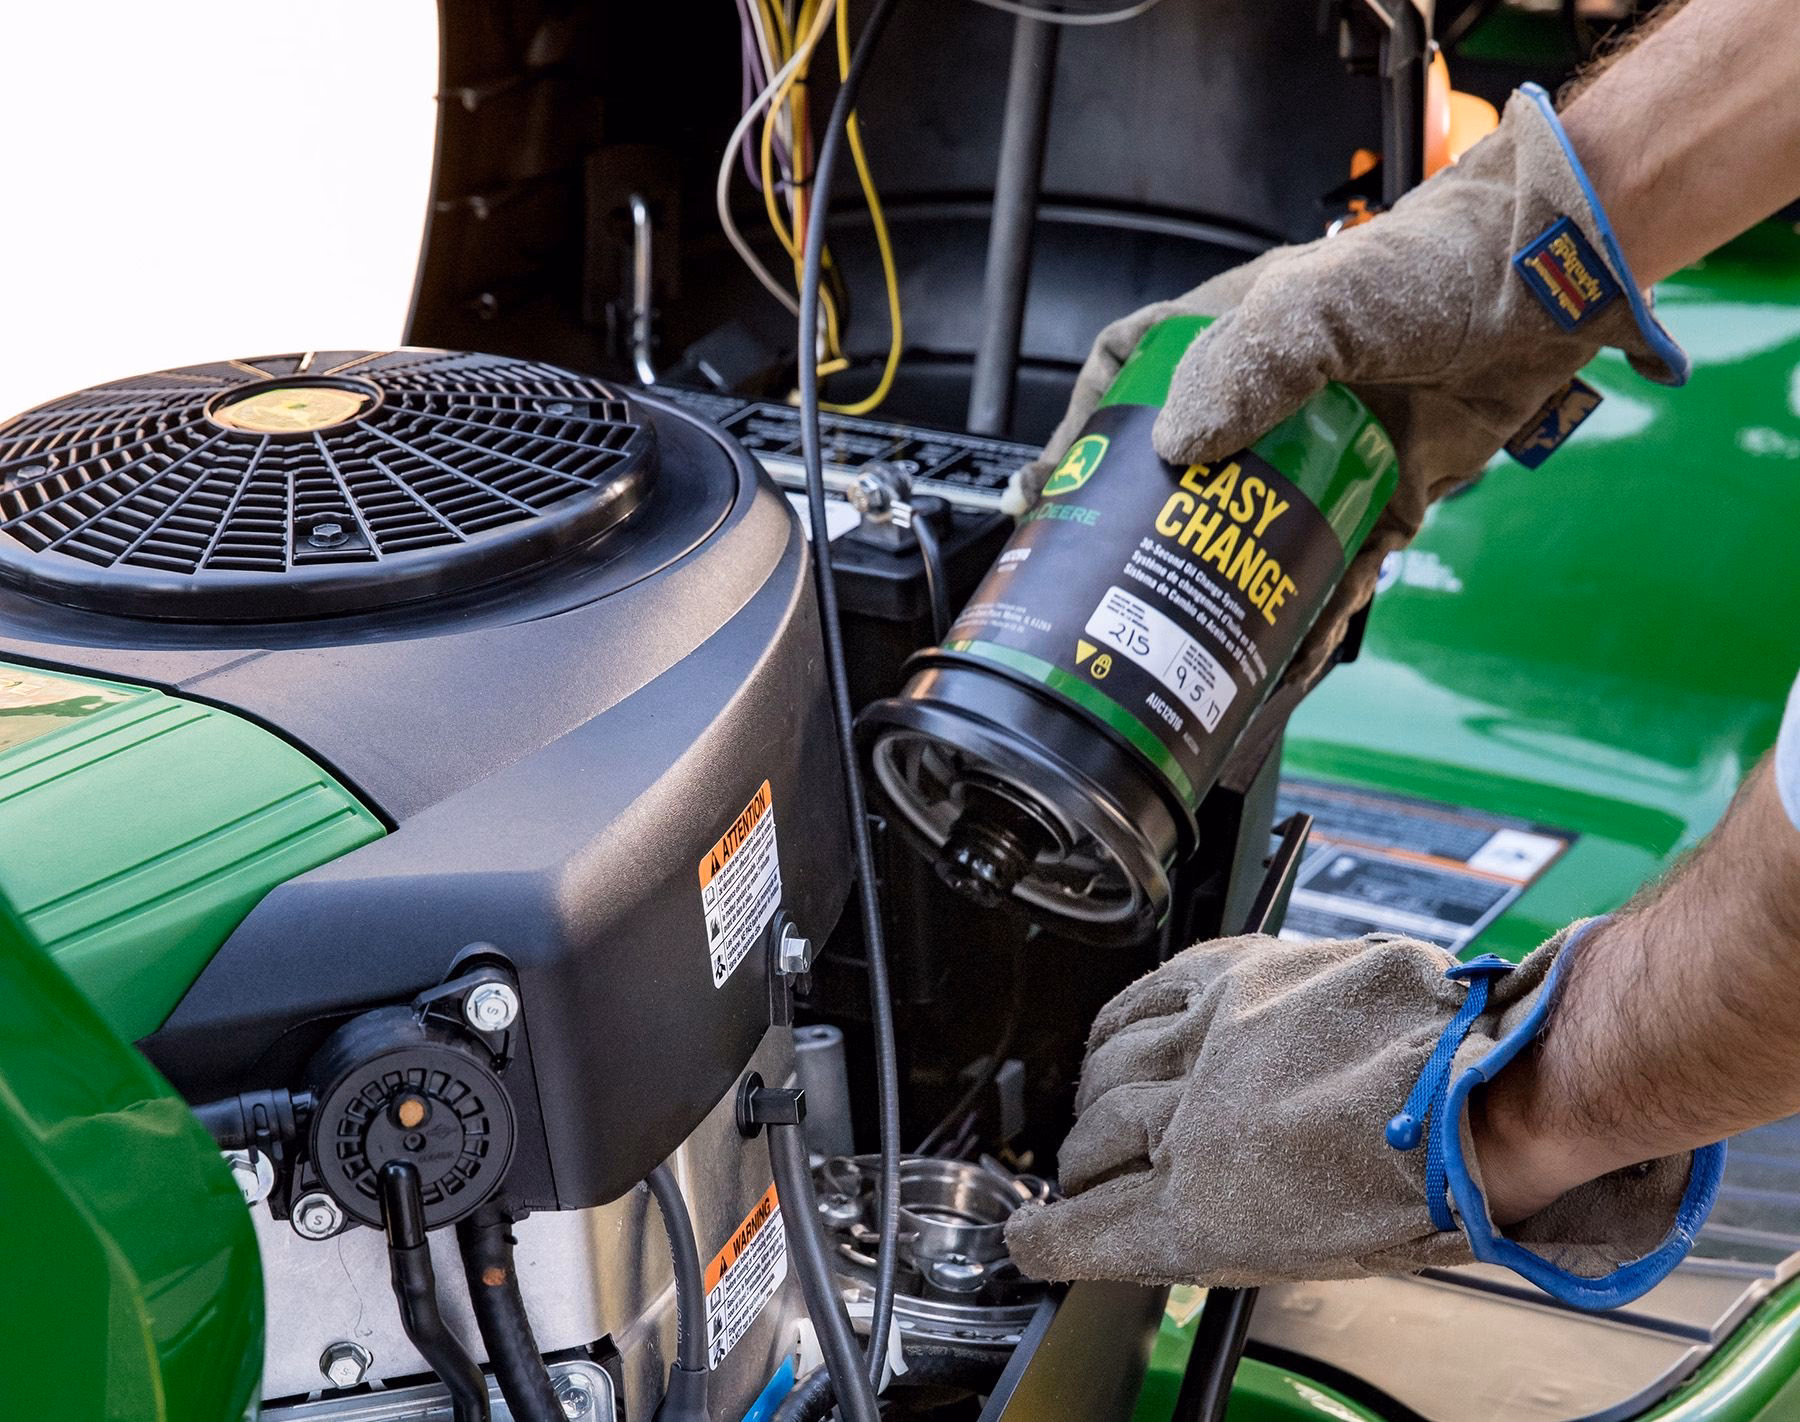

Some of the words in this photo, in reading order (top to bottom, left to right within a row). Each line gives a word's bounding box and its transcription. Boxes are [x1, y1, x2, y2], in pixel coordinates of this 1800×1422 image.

[1036, 502, 1101, 526] DEERE
[1179, 462, 1290, 538] EASY
[1139, 537, 1185, 570] 30-Second
[1183, 562, 1196, 578] Oil
[1195, 570, 1223, 599] Change
[1221, 592, 1246, 621] System
[1155, 491, 1296, 626] CHANGE
[1123, 563, 1157, 589] Sistema
[1156, 582, 1169, 597] de
[1168, 588, 1198, 617] Cambio
[1196, 612, 1207, 626] de
[1166, 570, 1179, 584] de
[1178, 578, 1223, 620] changement
[1109, 622, 1150, 656] 215
[723, 792, 766, 861] ATTENTION
[733, 1197, 771, 1257] WARNING
